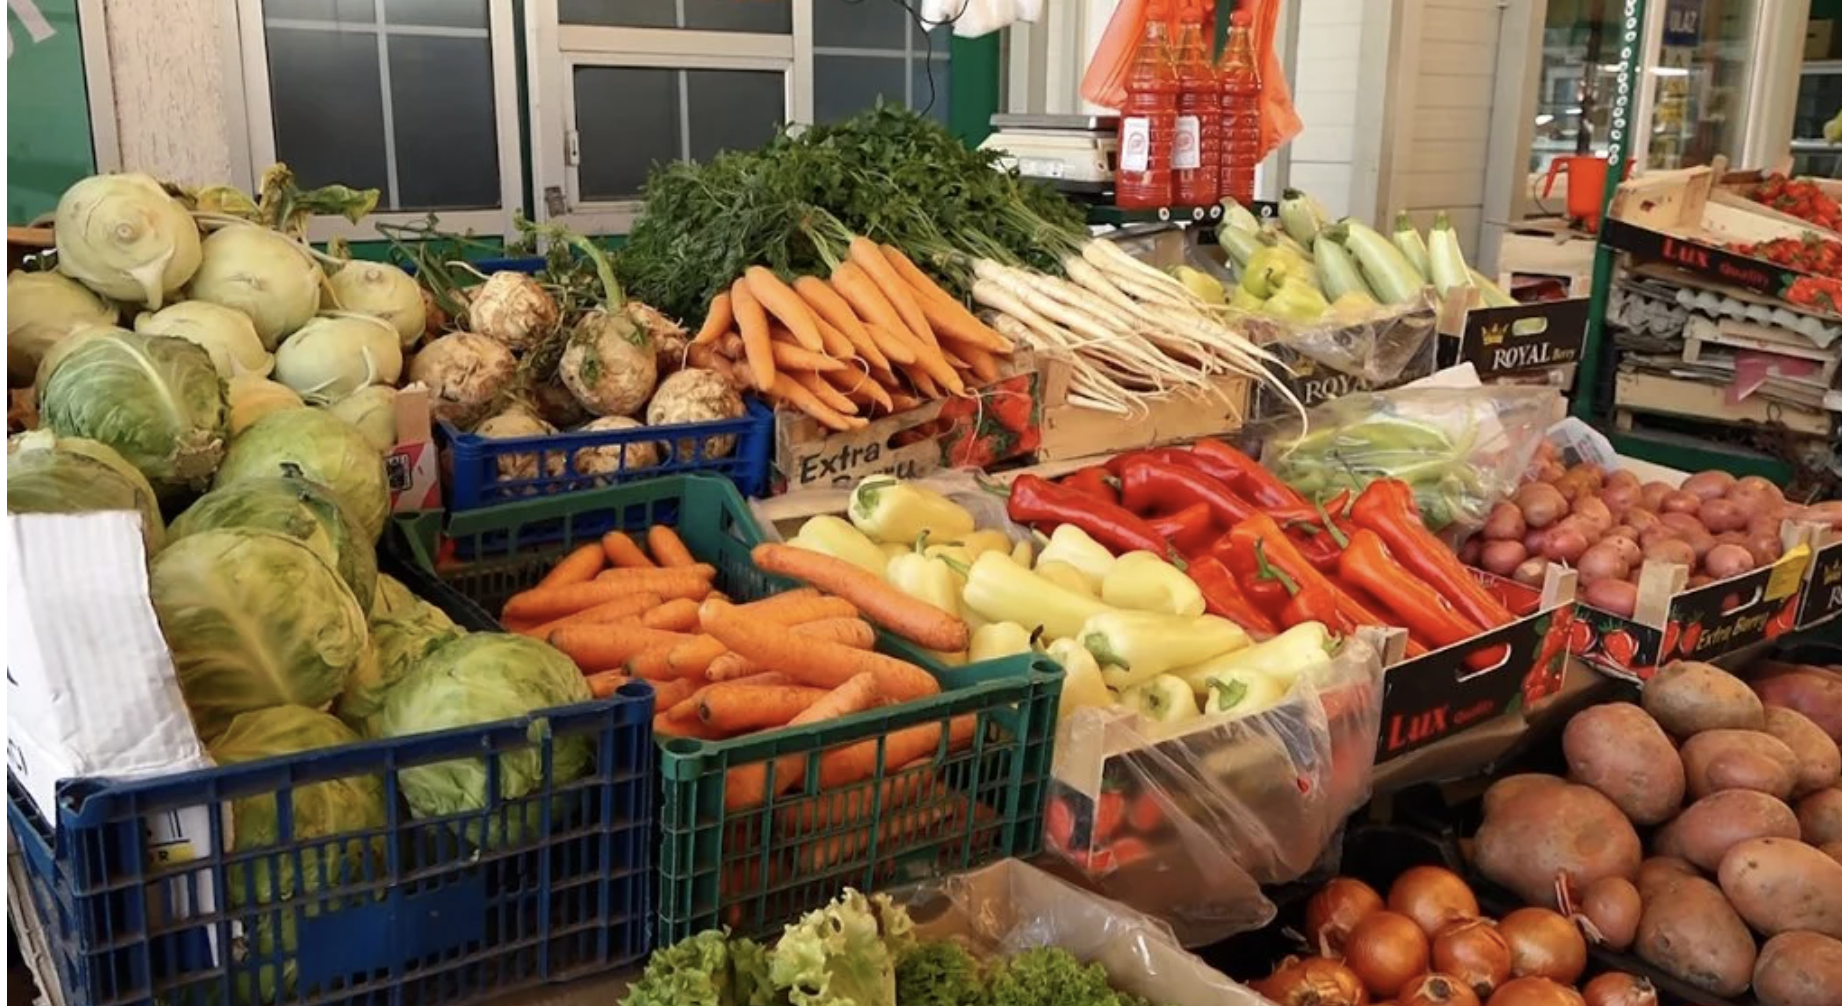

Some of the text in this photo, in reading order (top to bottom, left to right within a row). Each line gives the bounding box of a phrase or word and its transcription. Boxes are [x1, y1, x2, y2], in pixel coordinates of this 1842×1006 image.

[1663, 236, 1708, 269] Lux
[1492, 342, 1551, 370] ROYAL
[1305, 373, 1372, 403] ROYA
[800, 442, 880, 484] Extra
[1696, 612, 1769, 650] Extra Berry
[1388, 703, 1450, 751] Lux
